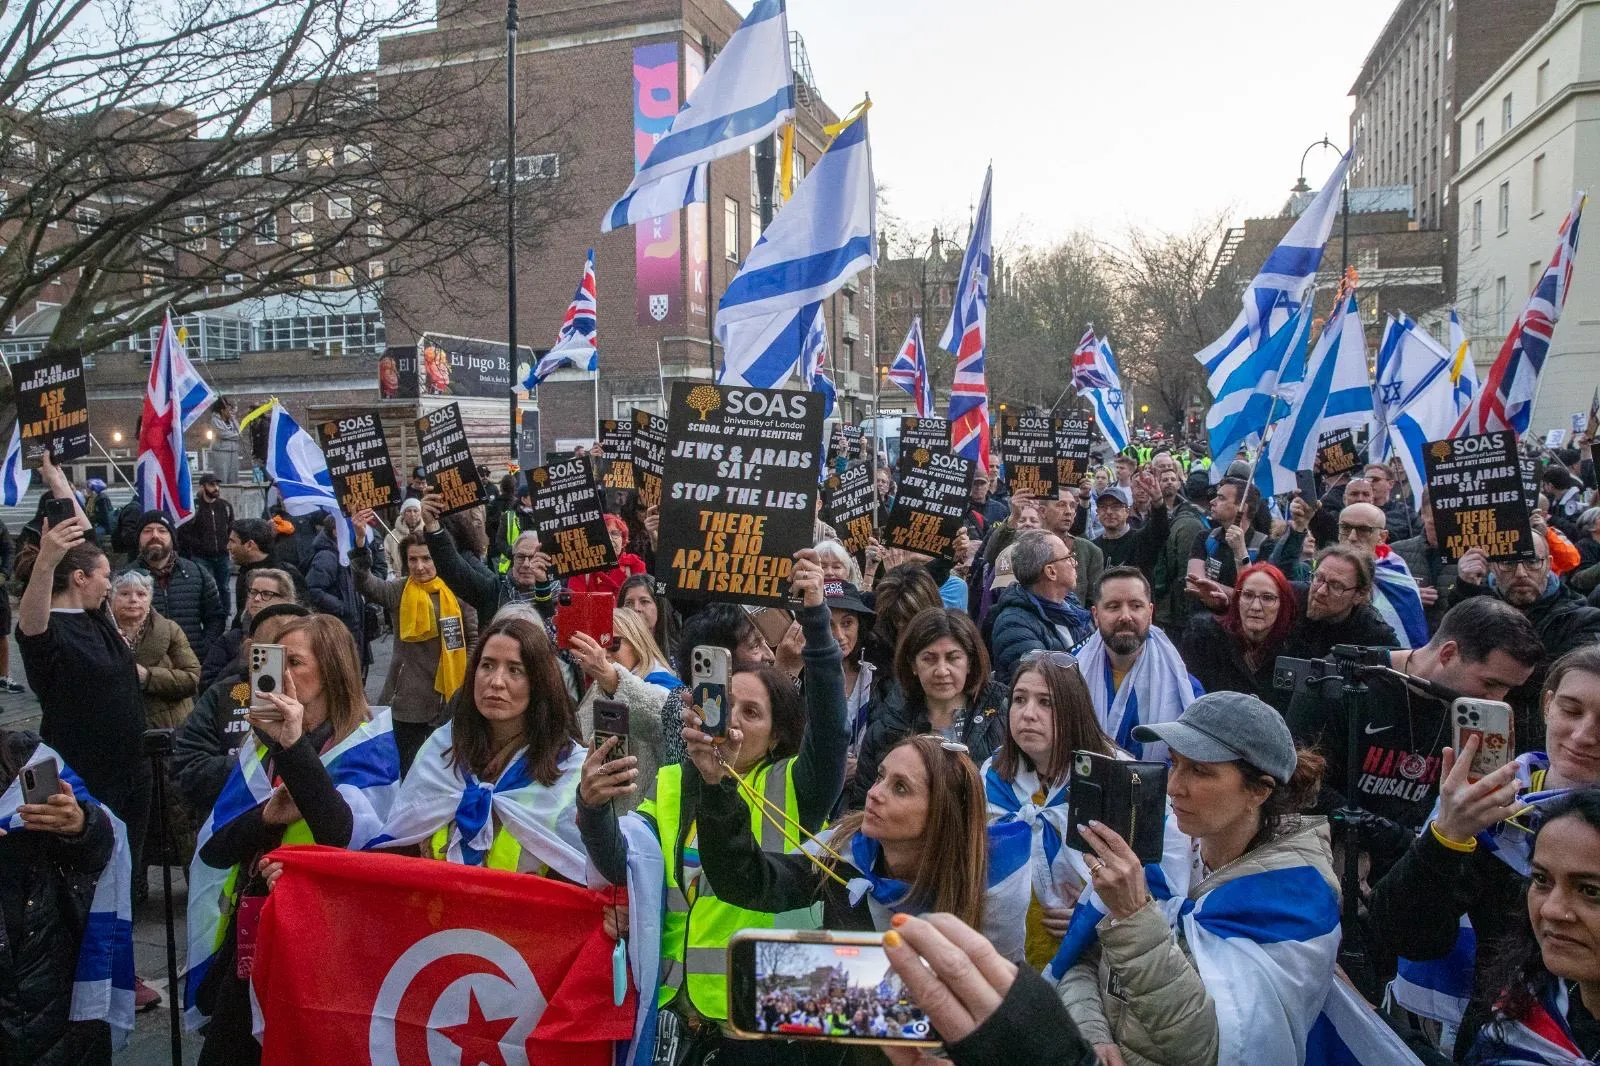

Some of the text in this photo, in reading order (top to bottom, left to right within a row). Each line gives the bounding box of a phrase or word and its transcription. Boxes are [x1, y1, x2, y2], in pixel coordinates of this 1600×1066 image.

[400, 358, 409, 371] El
[451, 352, 510, 372] El Jugo Ba
[20, 368, 79, 391] ARAB-ISRAELI
[35, 364, 62, 379] I'M AN
[40, 388, 65, 407] ASK
[726, 391, 807, 419] SOAS
[46, 403, 64, 419] ME
[429, 406, 455, 426] SOAS
[22, 408, 88, 438] ANYTHING
[339, 415, 374, 432] SOAS
[688, 423, 803, 440] SCHOOL OF ANTI SEMITISM
[724, 416, 806, 429] University of London
[919, 419, 946, 429] SOAS
[1020, 418, 1050, 429] SOAS
[1063, 420, 1088, 429] SOAS
[422, 442, 436, 455] JEWS
[437, 440, 442, 450] &
[443, 431, 464, 444] ARABS
[633, 437, 657, 452] JEWS &
[902, 436, 919, 444] JEWS
[927, 438, 949, 446] ARABS
[1030, 440, 1053, 448] ARABS
[1338, 431, 1350, 440] LIES
[1453, 434, 1504, 454] SOAS
[326, 438, 383, 458] JEWS & ARABS
[345, 451, 364, 461] SAY:
[435, 446, 450, 457] SAY:
[671, 441, 813, 468] JEWS & ARABS
[1455, 453, 1480, 461] University
[331, 457, 387, 476] STOP THE LIES
[426, 450, 469, 474] STOP THE LIES
[549, 460, 585, 480] SOAS
[634, 457, 649, 469] STOP
[651, 462, 664, 475] THE
[717, 461, 762, 481] SAY:
[930, 453, 968, 472] SOAS
[1015, 465, 1040, 473] THERE
[345, 471, 373, 485] THERE
[436, 466, 459, 483] THERE
[840, 464, 867, 483] SOAS
[1431, 466, 1515, 486] JEWS & ARABS
[343, 486, 391, 504] APARTHEID
[902, 475, 967, 497] JEWS & ARABS
[923, 488, 944, 500] SAY:
[1458, 481, 1486, 492] SAY:
[535, 488, 594, 510] JEWS & ARABS
[672, 482, 720, 502] STOP
[726, 487, 762, 506] THE
[765, 490, 807, 510] LIES
[831, 497, 847, 509] JEWS
[847, 493, 853, 501] &
[854, 484, 875, 498] ARABS
[1436, 490, 1519, 510] STOP THE LIES
[555, 503, 575, 515] SAY:
[835, 506, 864, 523] STOP THE
[899, 496, 962, 517] STOP THE LIES
[540, 510, 600, 531] STOP THE LIES
[699, 510, 768, 535] THERE
[908, 511, 944, 527] THERE
[1455, 508, 1496, 524] THERE
[553, 527, 587, 544] THERE
[892, 526, 950, 546] APARTHEID
[1462, 520, 1497, 536] IS NO
[561, 538, 588, 552] IS NO
[704, 532, 763, 555] IS NO
[1446, 530, 1520, 547] APARTHEID
[551, 544, 607, 565] APARTHEID
[672, 548, 792, 578] APARTHEID
[557, 555, 608, 575] IN ISRAEL
[678, 569, 701, 590] IN
[708, 572, 782, 597] ISRAEL
[224, 721, 250, 733] JEW
